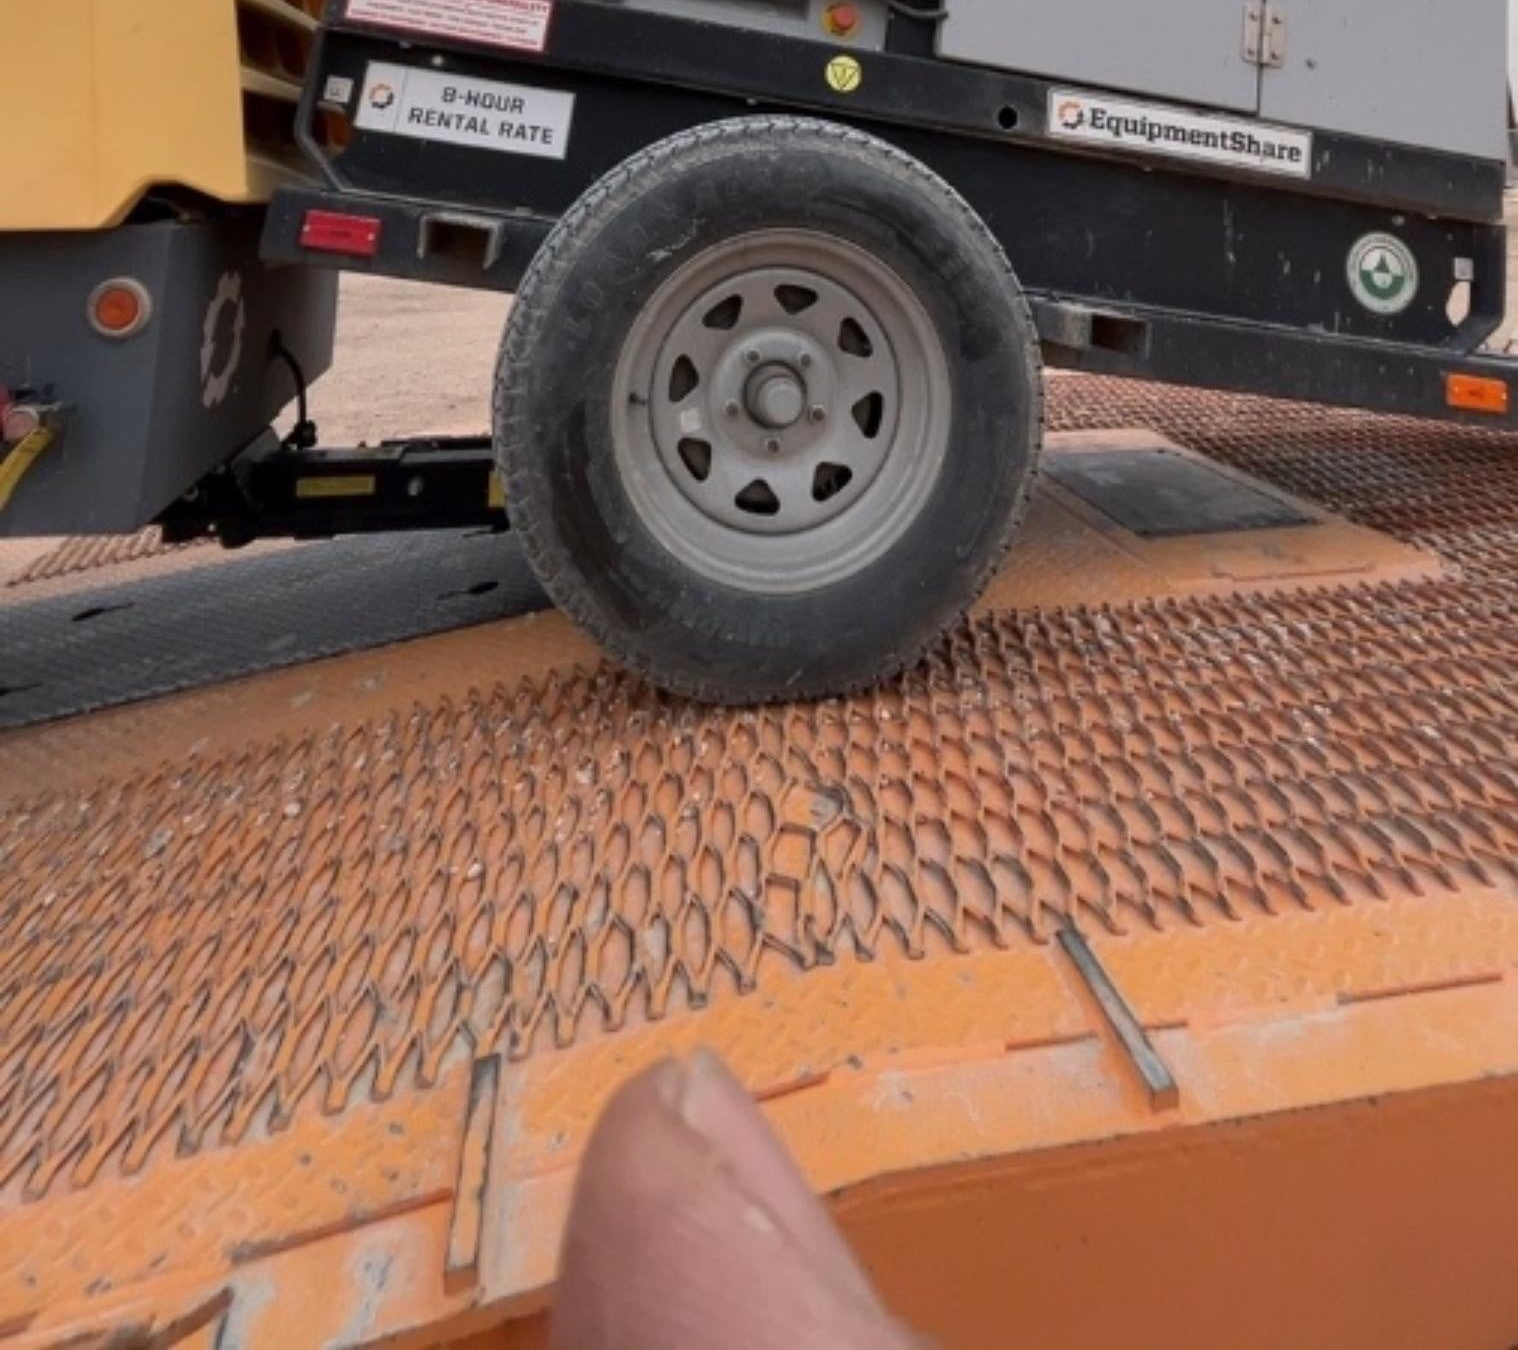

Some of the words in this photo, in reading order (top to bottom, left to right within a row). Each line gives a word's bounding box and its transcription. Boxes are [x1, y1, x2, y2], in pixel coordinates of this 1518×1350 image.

[441, 85, 526, 116] 8-HOUR
[407, 106, 491, 136] RENTAL
[498, 120, 554, 145] RATE
[1089, 106, 1303, 164] EquipmentShare
